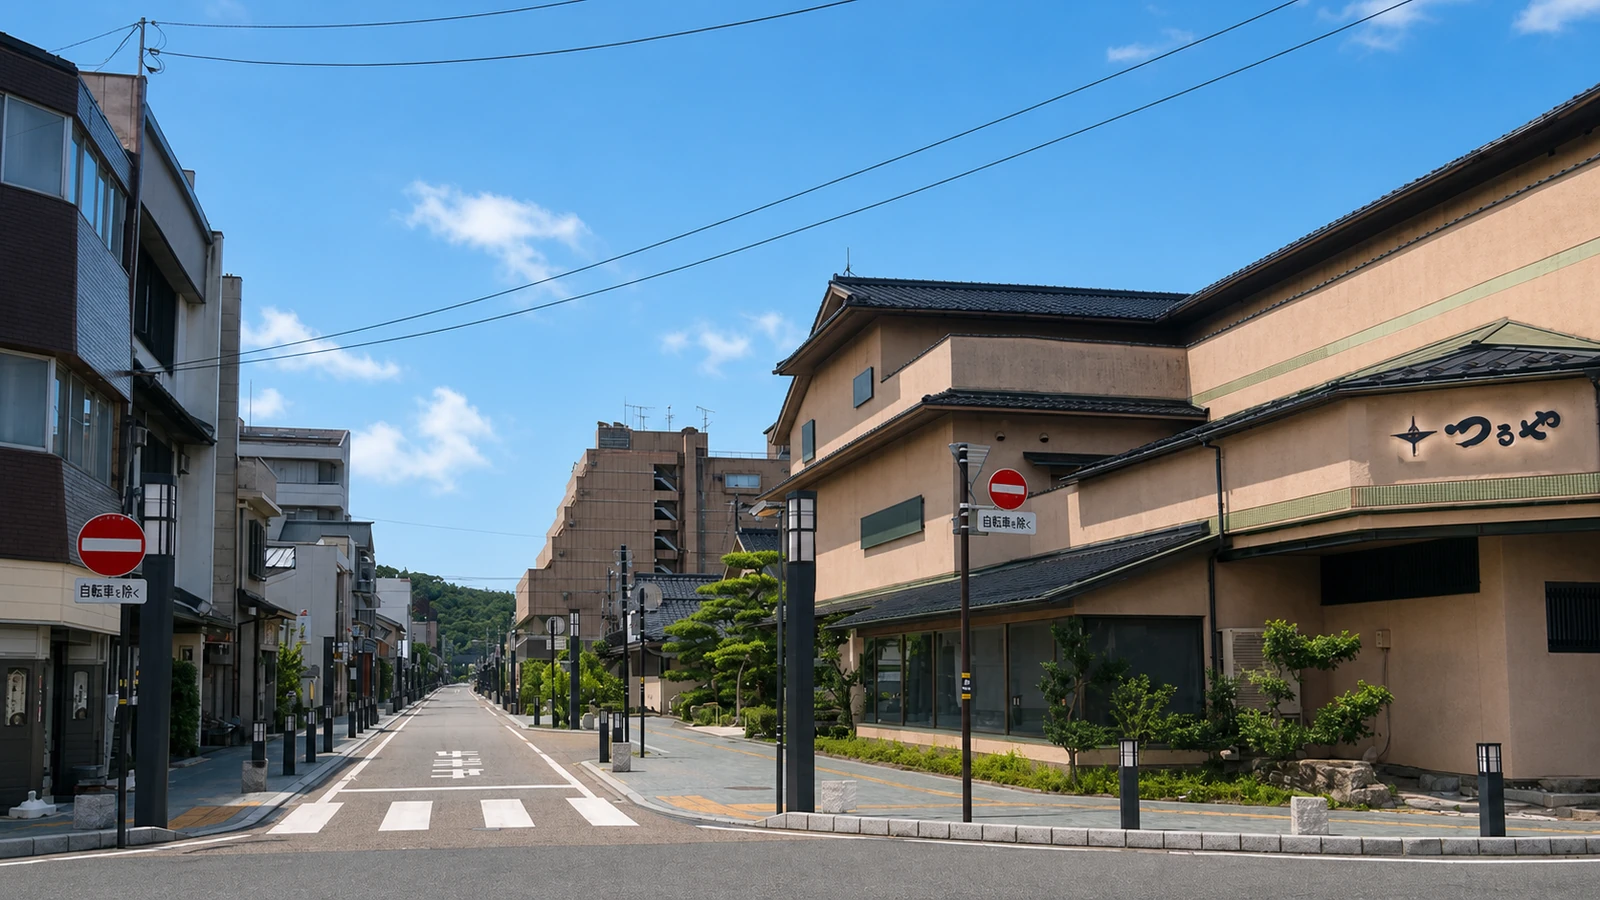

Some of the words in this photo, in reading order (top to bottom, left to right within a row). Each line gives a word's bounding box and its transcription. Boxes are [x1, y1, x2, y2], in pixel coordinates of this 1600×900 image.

[1444, 410, 1561, 448] つるや
[983, 515, 1031, 529] 自転車を除く
[80, 583, 140, 599] 自転車を除く
